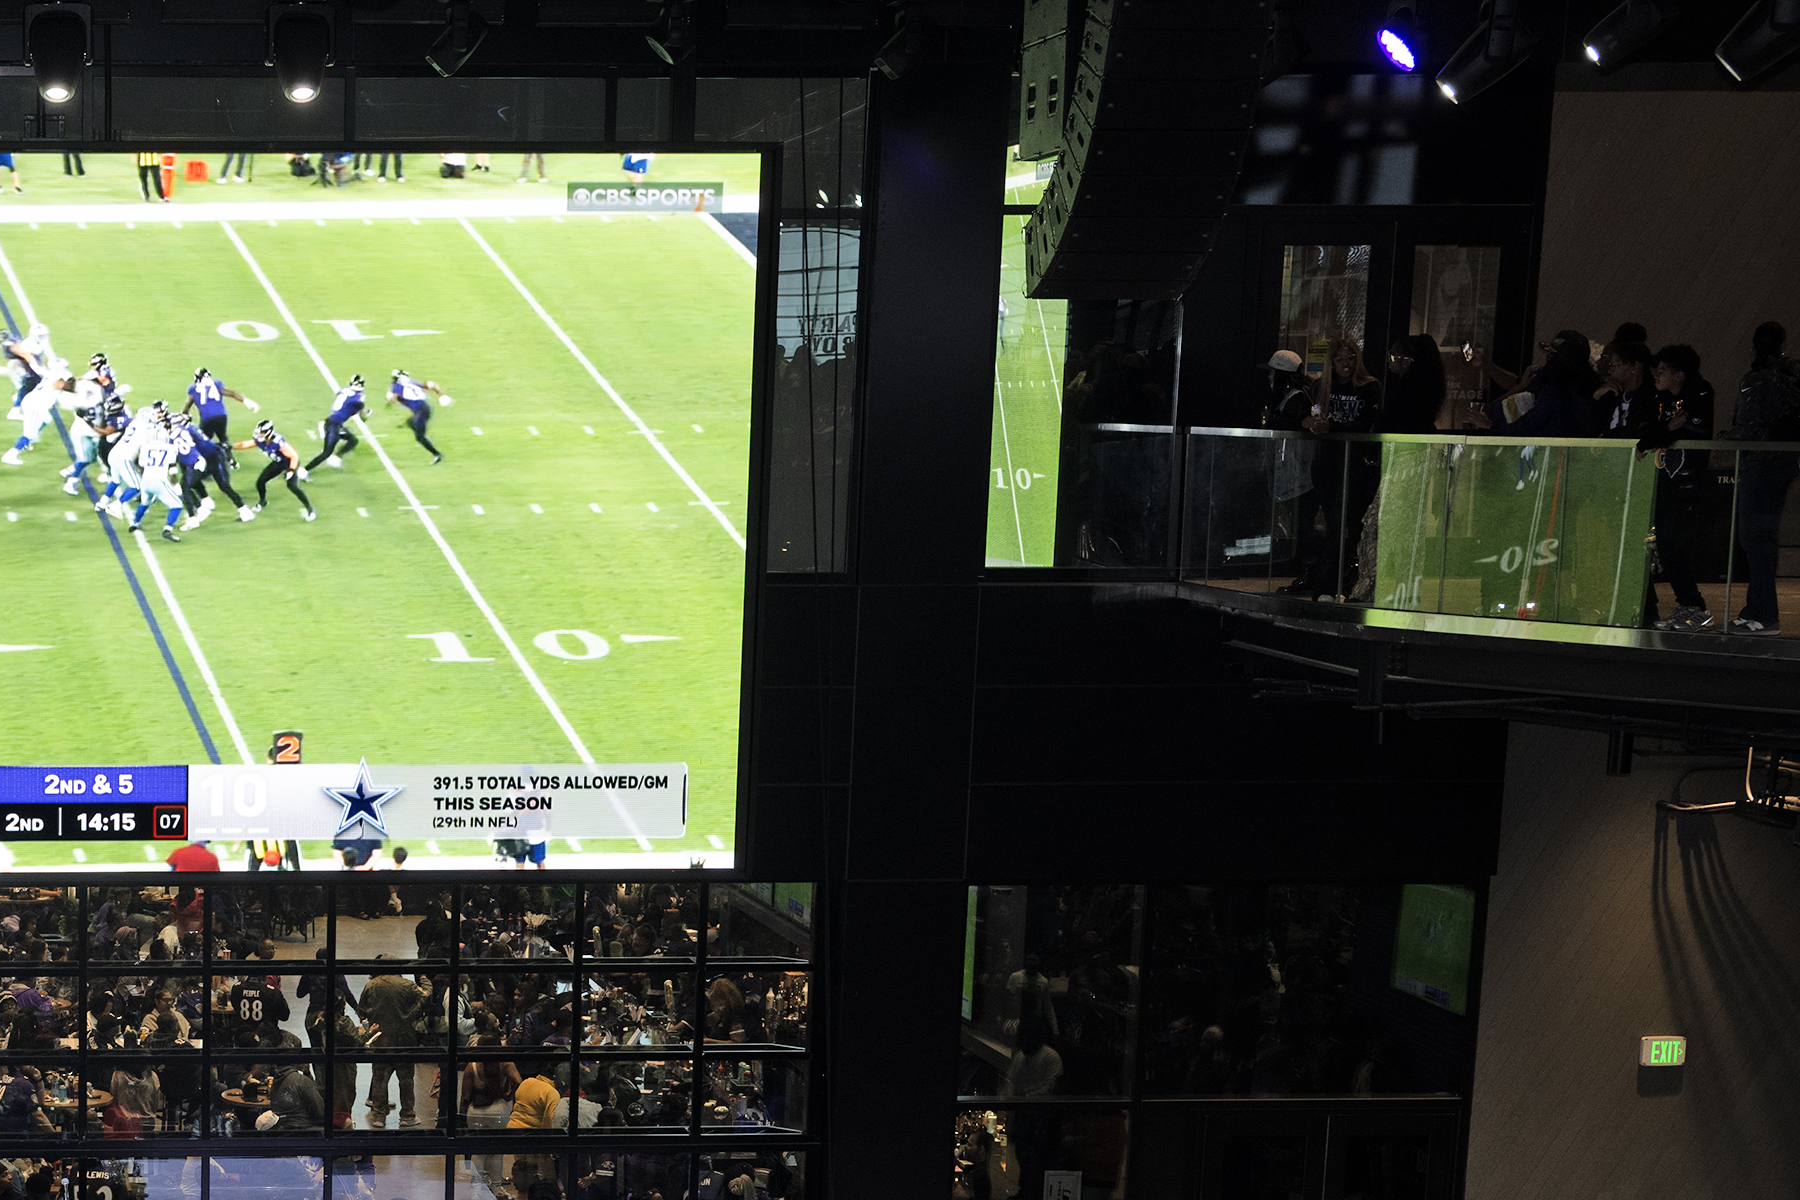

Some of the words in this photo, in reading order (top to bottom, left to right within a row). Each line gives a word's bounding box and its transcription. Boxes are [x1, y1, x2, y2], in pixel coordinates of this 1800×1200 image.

[590, 188, 647, 207] CBS
[652, 188, 715, 207] SPORTS
[44, 774, 87, 796] 2ND
[92, 774, 113, 796] &
[118, 774, 134, 796] 5
[432, 776, 474, 791] 391.5
[477, 776, 526, 790] TOTAL
[529, 776, 561, 790] YDS
[564, 775, 669, 791] ALLOWED/GM
[204, 770, 268, 818] 10
[433, 797, 475, 811] THIS
[478, 797, 552, 811] SEASON
[4, 812, 44, 832] 2ND
[76, 812, 136, 832] 14:15
[159, 814, 182, 830] 07
[432, 816, 468, 829] (29th
[470, 817, 484, 828] IN
[486, 816, 519, 829] NFL)
[242, 989, 261, 998] PEOPLE
[239, 998, 263, 1021] 88
[1650, 1041, 1681, 1063] EXIT
[86, 1171, 110, 1180] LEWIS
